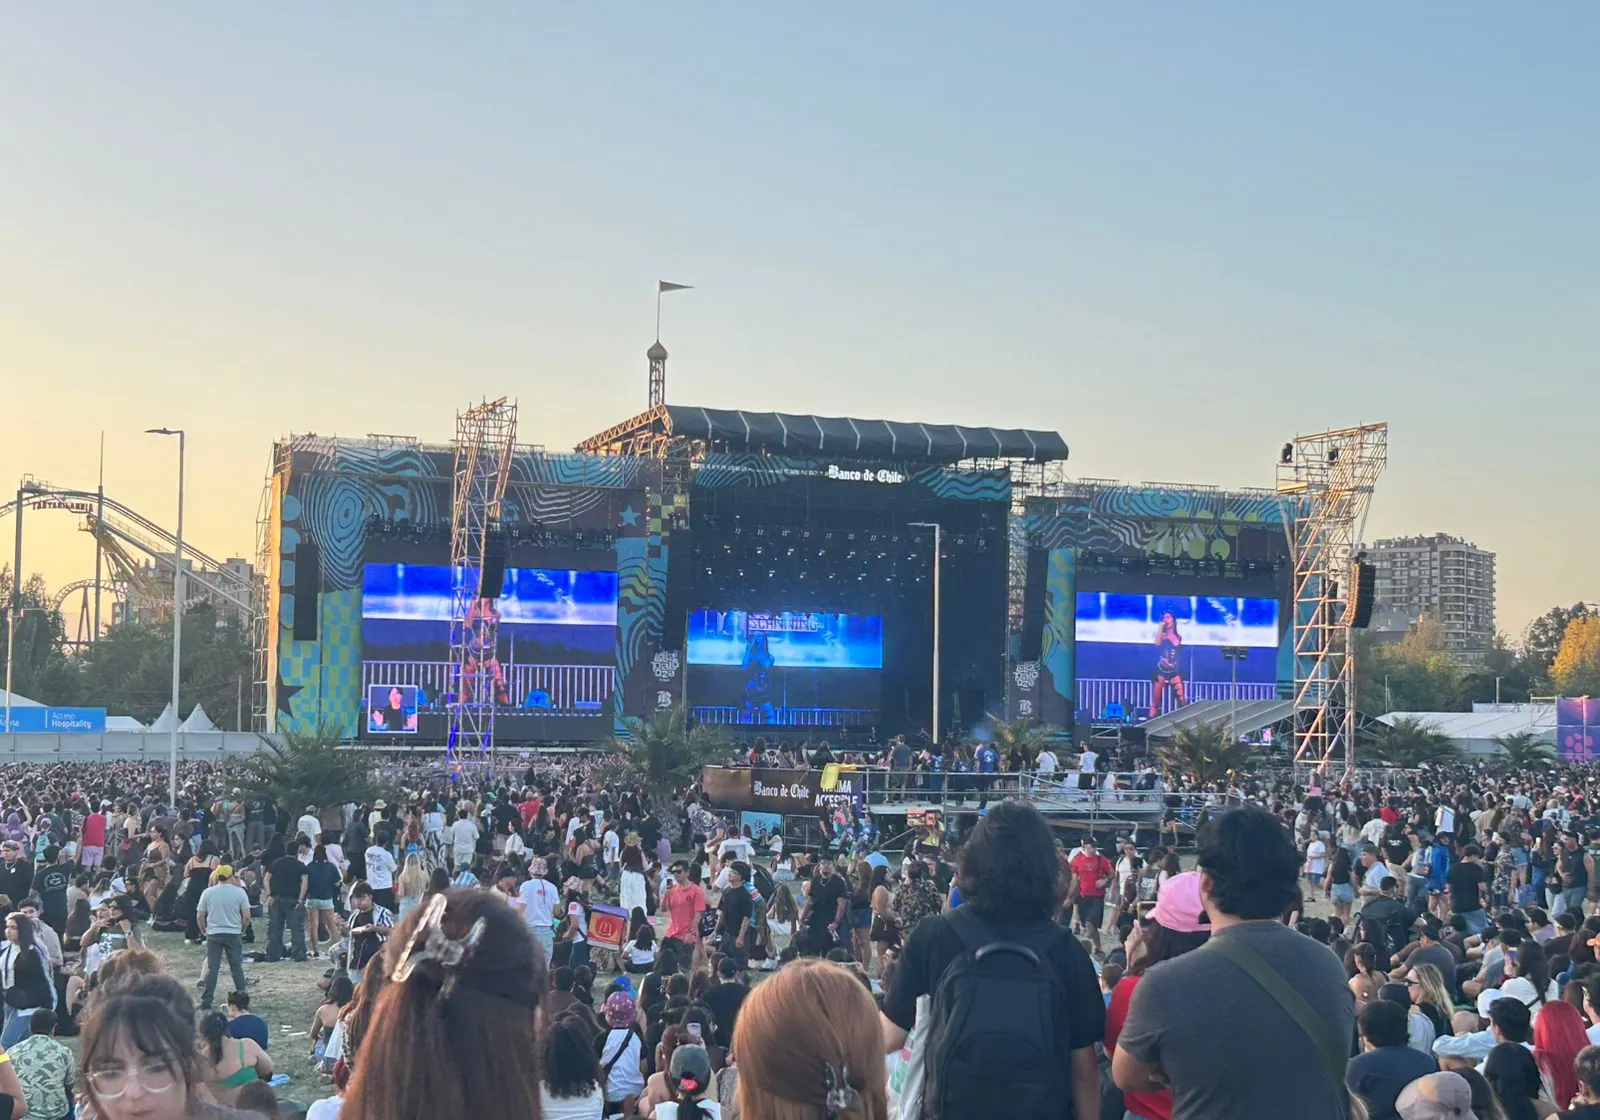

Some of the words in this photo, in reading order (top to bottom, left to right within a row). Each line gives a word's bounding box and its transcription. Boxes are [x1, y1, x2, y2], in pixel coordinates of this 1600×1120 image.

[828, 464, 861, 480] Banco
[863, 469, 874, 481] de
[877, 469, 903, 483] Chile
[51, 719, 92, 730] Hospitality
[754, 780, 778, 797] Banco
[780, 783, 788, 797] de
[790, 783, 809, 799] Chile
